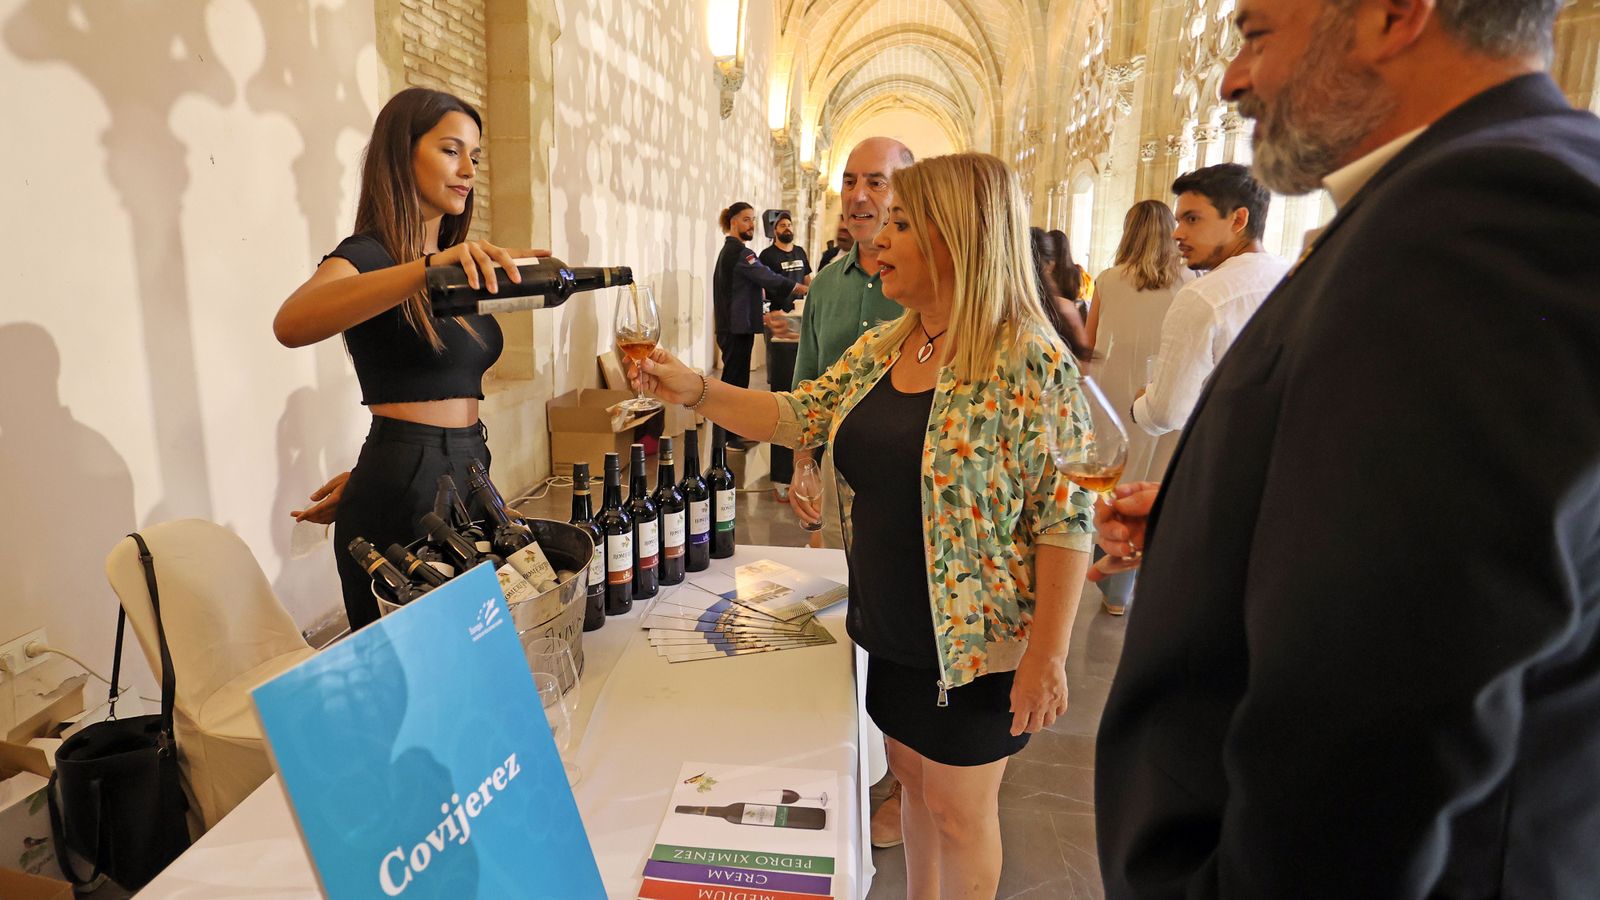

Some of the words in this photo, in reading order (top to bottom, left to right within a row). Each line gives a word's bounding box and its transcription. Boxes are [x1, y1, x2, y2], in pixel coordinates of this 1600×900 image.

[379, 752, 521, 897] Covijerez
[673, 849, 750, 864] XIMÉNEZ
[755, 855, 812, 869] PEDRO
[707, 869, 768, 885] CREAM
